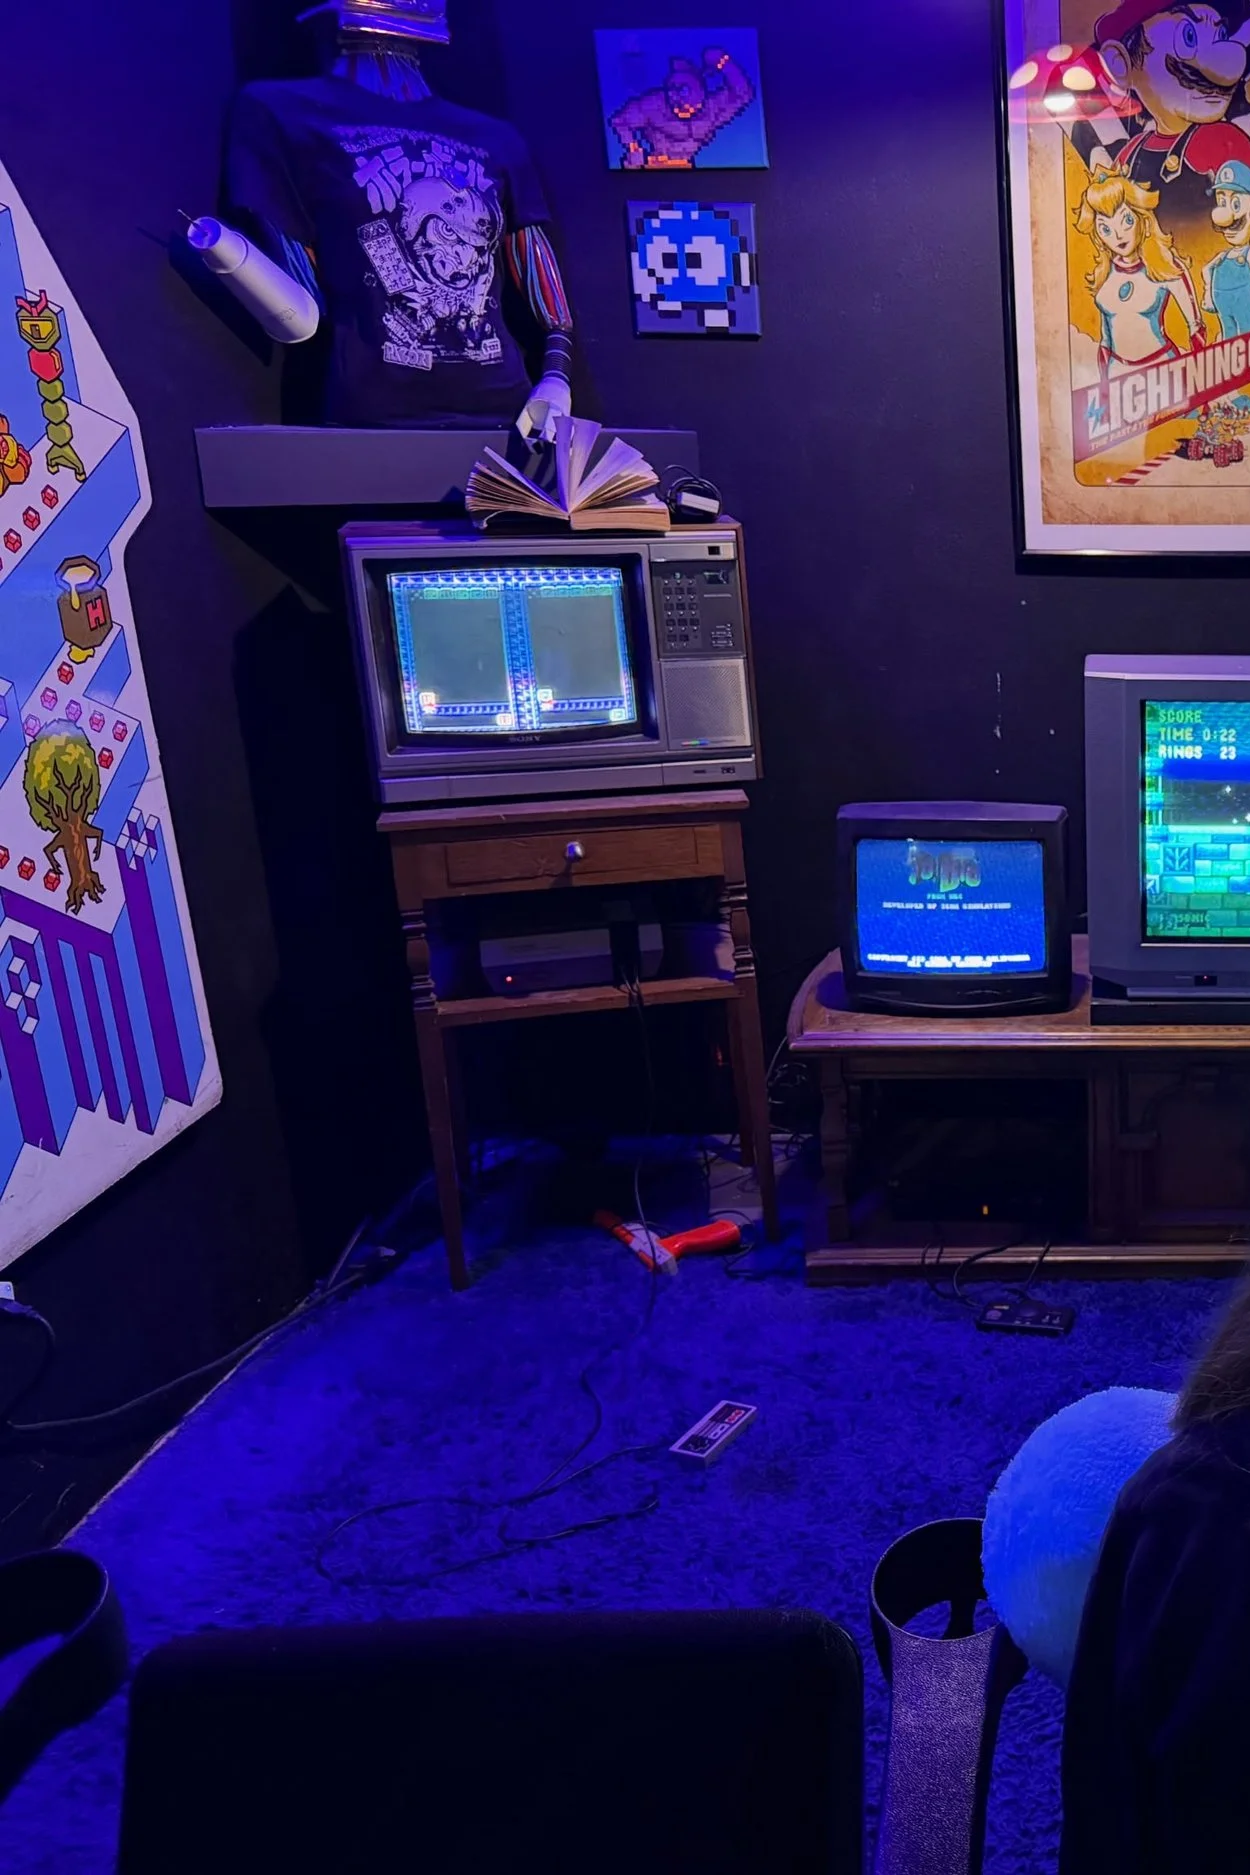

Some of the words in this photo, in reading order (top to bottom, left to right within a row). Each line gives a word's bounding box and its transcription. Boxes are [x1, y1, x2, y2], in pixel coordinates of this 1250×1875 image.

[1087, 338, 1246, 440] LIGHTNING
[1158, 709, 1202, 724] SCORE
[1159, 728, 1194, 742] TIME
[1202, 728, 1236, 742] 0:22
[1158, 745, 1203, 760] RINGS
[1219, 745, 1237, 760] 23
